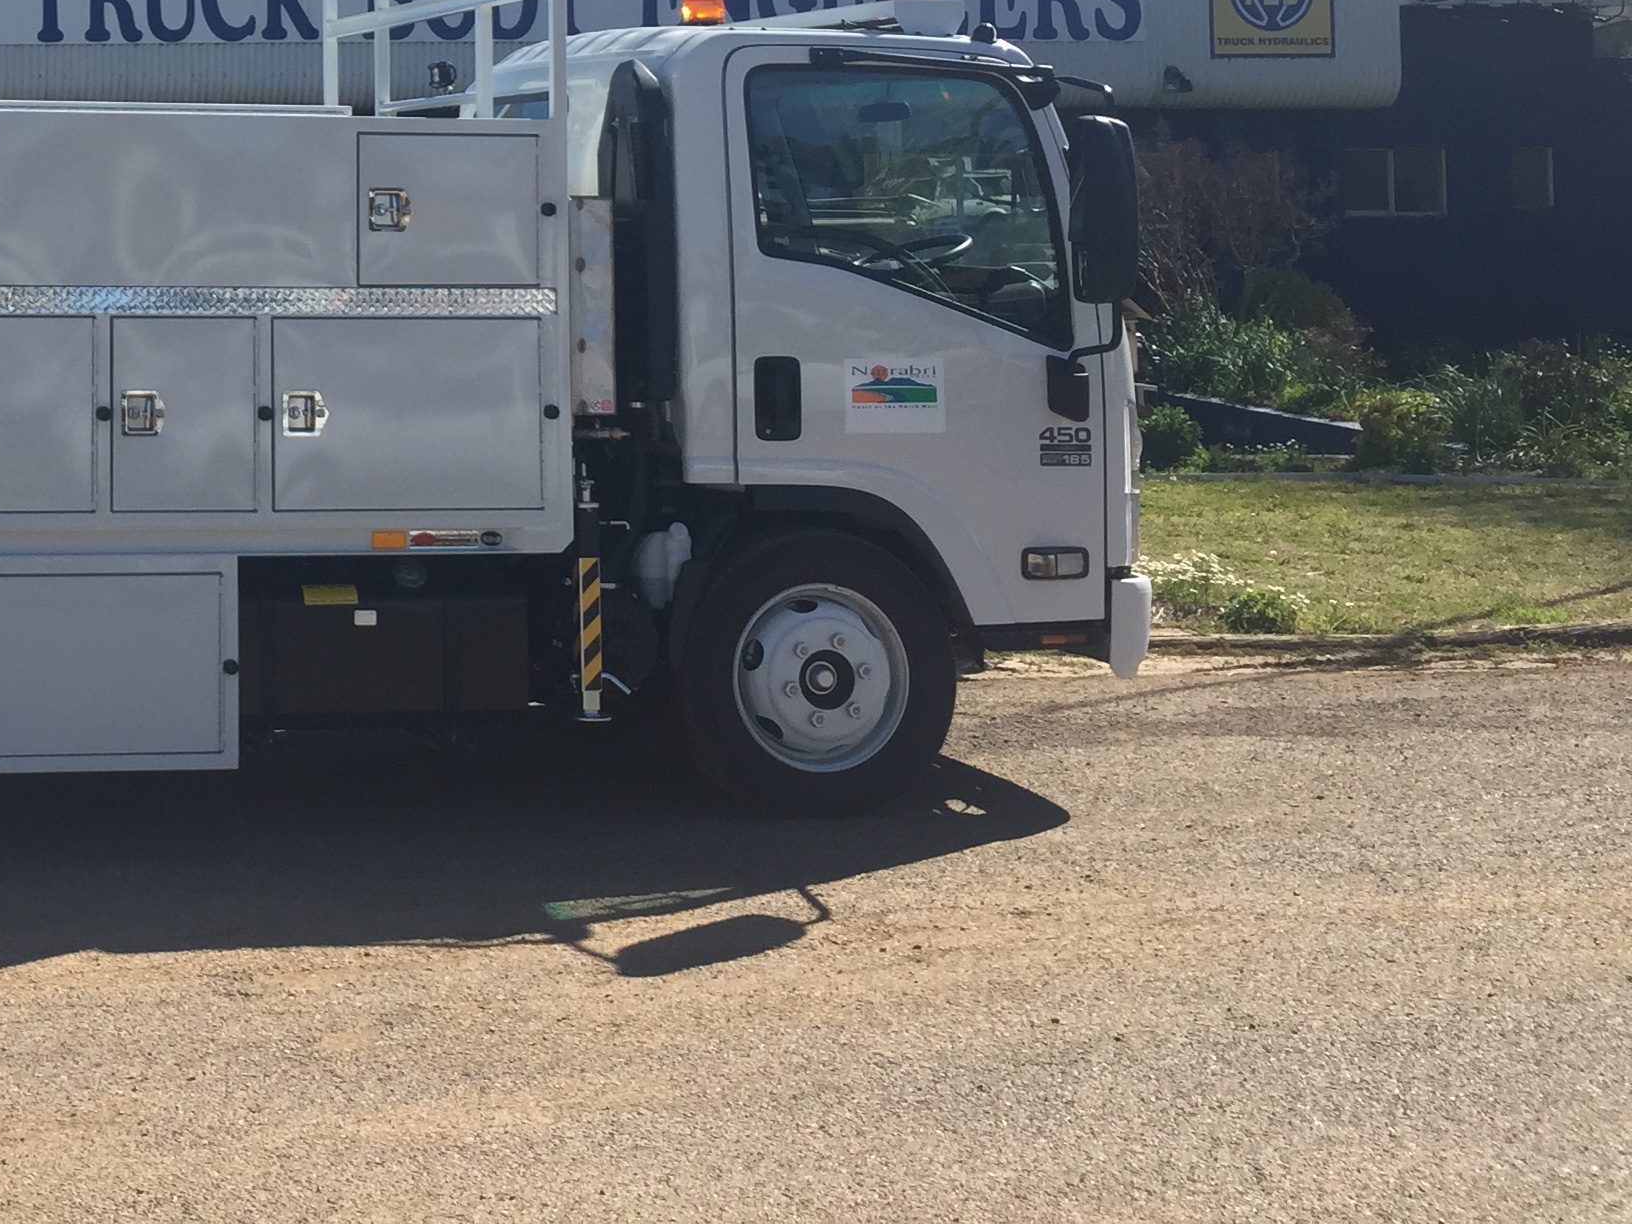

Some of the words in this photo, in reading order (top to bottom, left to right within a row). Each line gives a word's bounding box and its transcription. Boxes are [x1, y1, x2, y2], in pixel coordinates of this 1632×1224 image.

[1216, 36, 1256, 47] TRUCK
[1257, 36, 1330, 47] HYDRAULICS
[1038, 426, 1092, 444] 450
[1062, 454, 1091, 465] 185
